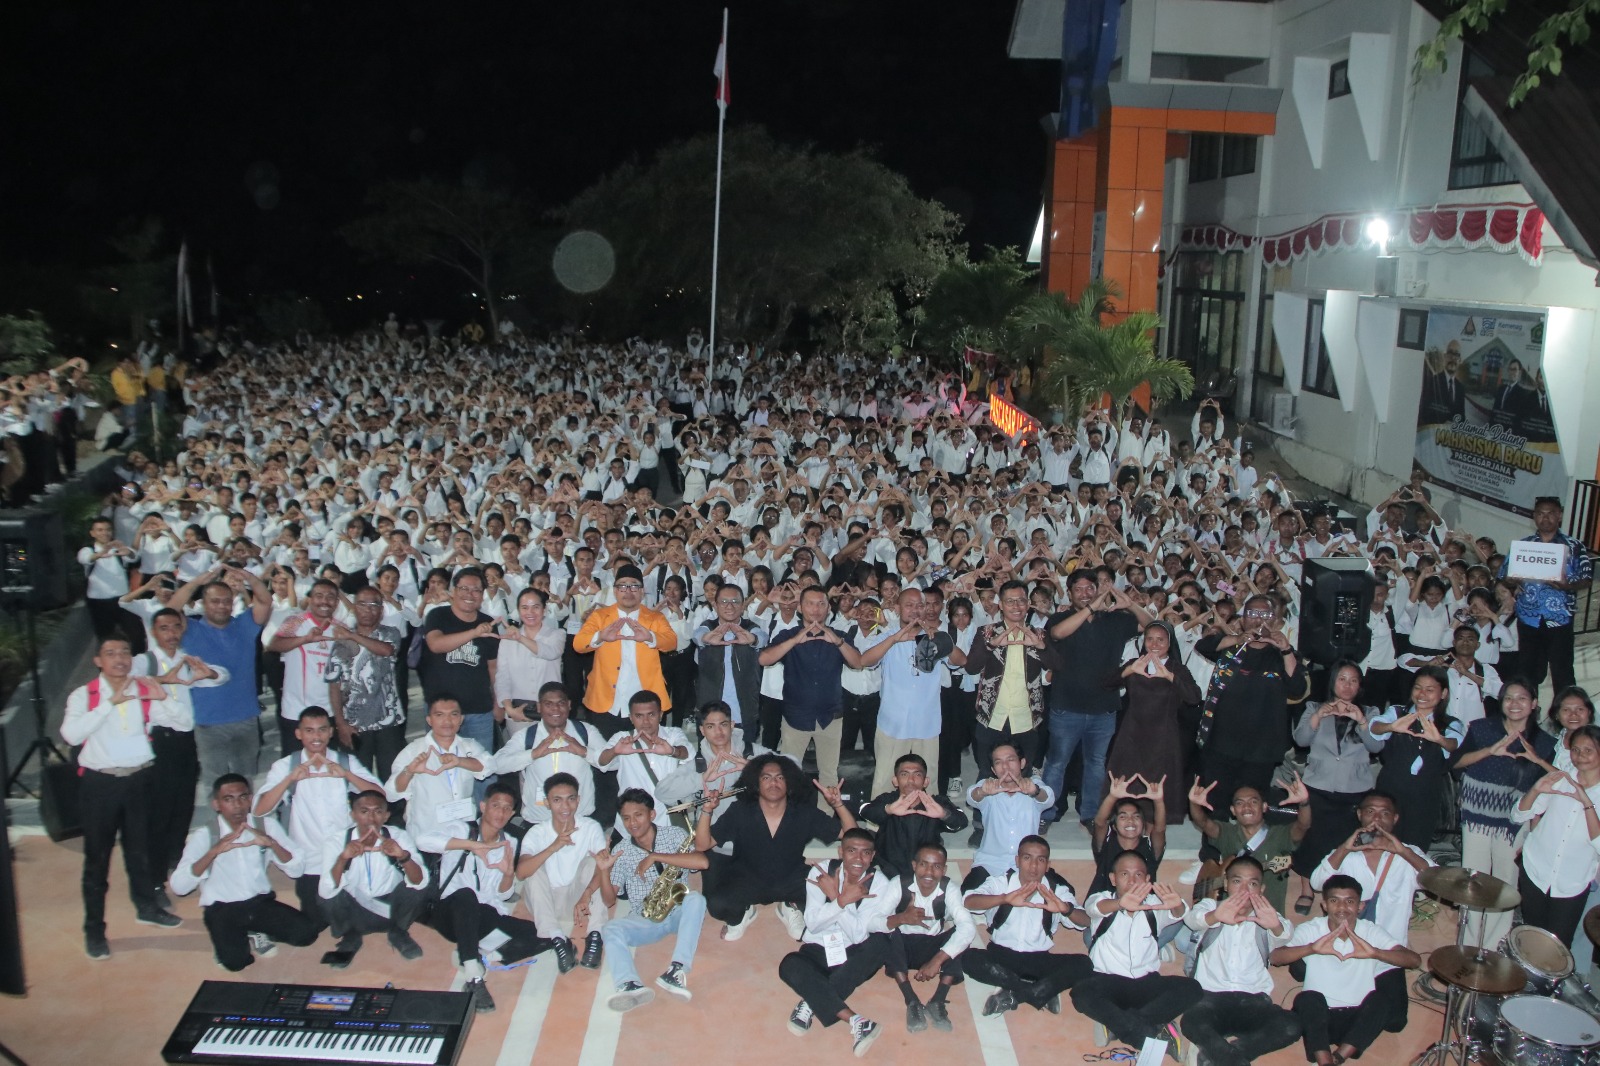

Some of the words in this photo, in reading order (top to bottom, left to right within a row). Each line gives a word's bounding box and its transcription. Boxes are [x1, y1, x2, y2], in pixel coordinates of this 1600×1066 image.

[1451, 414, 1489, 438] Selamat
[1490, 424, 1527, 449] Datang
[1435, 428, 1502, 463] MAHASISWA
[1503, 445, 1543, 475] BARU
[1454, 452, 1511, 475] PASCASARJANA
[1516, 554, 1557, 565] FLORES
